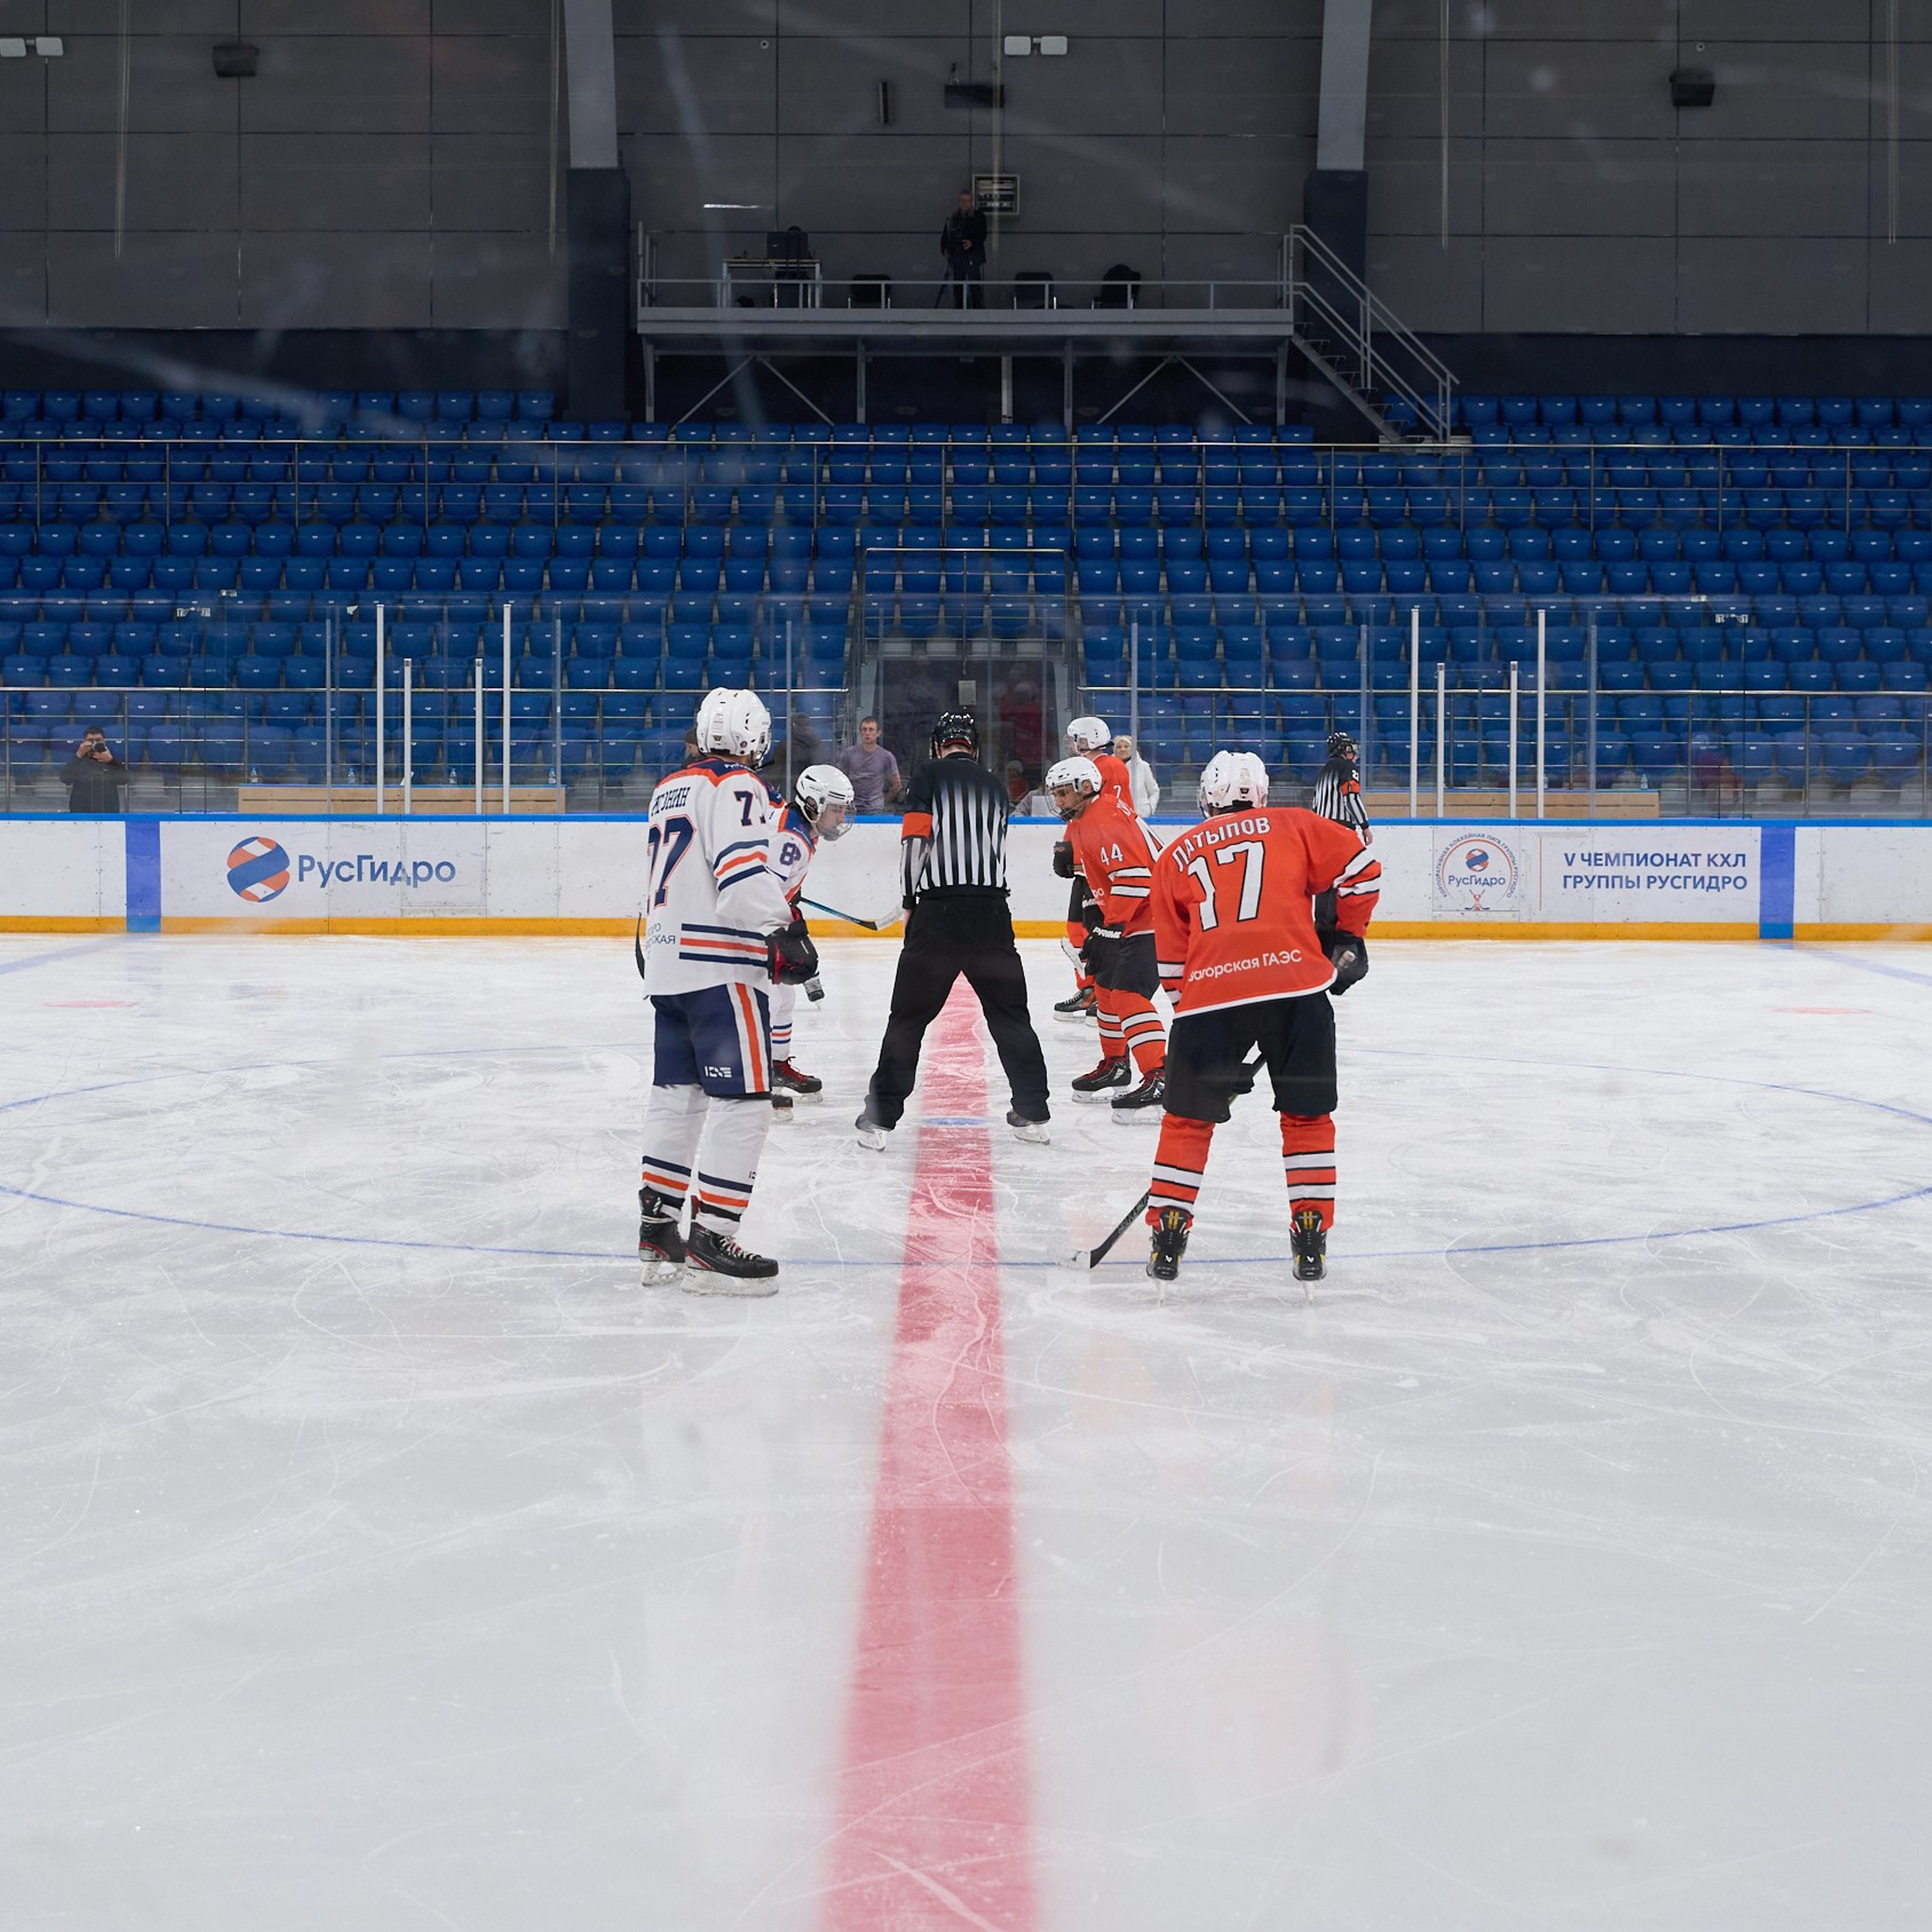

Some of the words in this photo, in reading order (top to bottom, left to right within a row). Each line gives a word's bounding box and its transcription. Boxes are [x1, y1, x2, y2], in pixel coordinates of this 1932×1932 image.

[1171, 817, 1272, 873] ЛАТЫПОВ
[1486, 834, 1501, 844] ЛИГА
[1100, 843, 1123, 866] 44
[1500, 842, 1518, 866] ГРУППЫ
[1564, 853, 1577, 867] V
[1580, 853, 1702, 868] ЧЕМПИОНАТ
[1706, 854, 1746, 868] КХЛ
[298, 855, 456, 888] РусГидро
[1448, 875, 1506, 888] РусГидро
[1187, 840, 1266, 932] 17
[1506, 866, 1518, 898] РУСГИДРО
[1563, 875, 1641, 890] ГРУППЫ
[1646, 875, 1748, 893] РУСГИДРО
[1092, 926, 1121, 939] PRIME
[1262, 949, 1302, 967] ГАЭС
